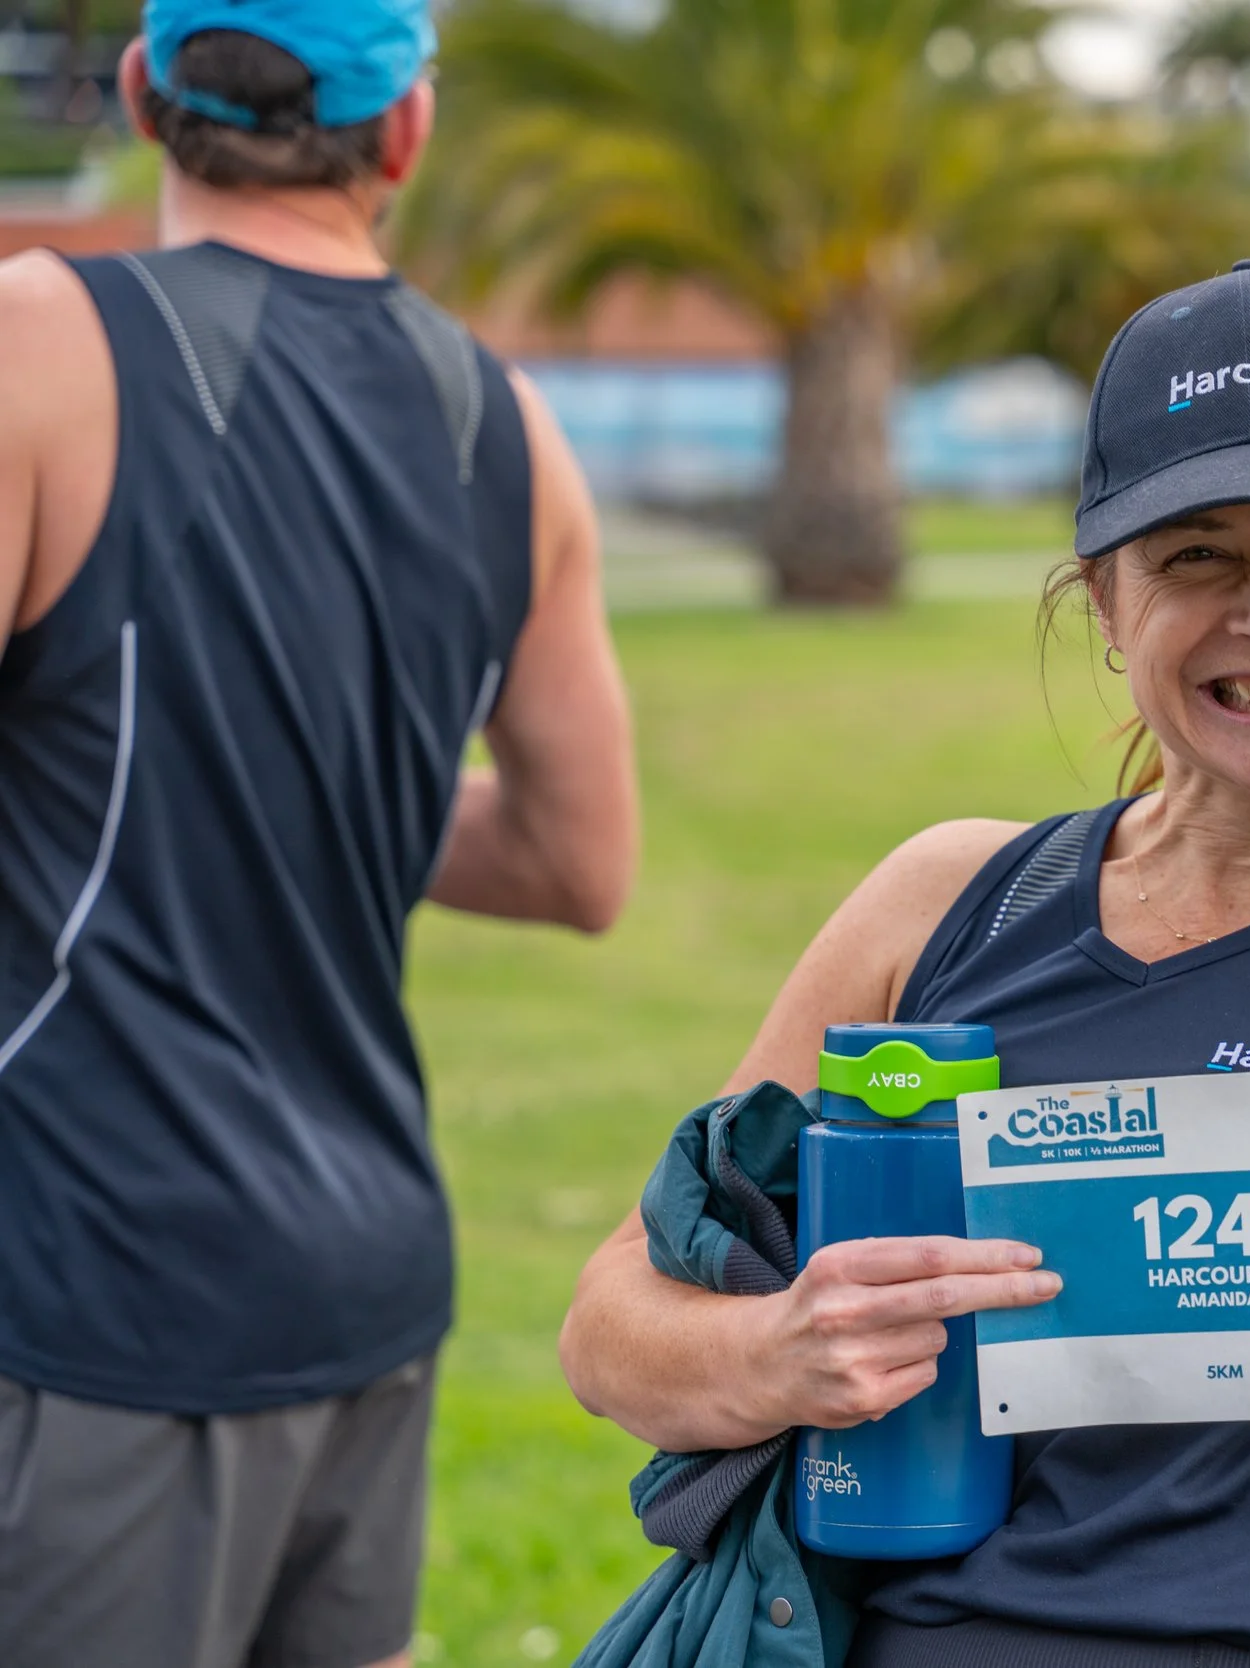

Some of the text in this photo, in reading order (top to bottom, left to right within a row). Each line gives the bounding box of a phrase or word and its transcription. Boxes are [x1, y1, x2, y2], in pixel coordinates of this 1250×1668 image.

[867, 1072, 921, 1089] CBAY
[1007, 1085, 1158, 1139] Coastal
[1036, 1096, 1070, 1111] The
[1041, 1149, 1055, 1158] 5K
[1063, 1147, 1082, 1157] 10K
[1103, 1143, 1160, 1155] MARATHON
[1206, 1364, 1244, 1379] 5KM
[802, 1451, 853, 1482] frank
[806, 1474, 862, 1502] green
